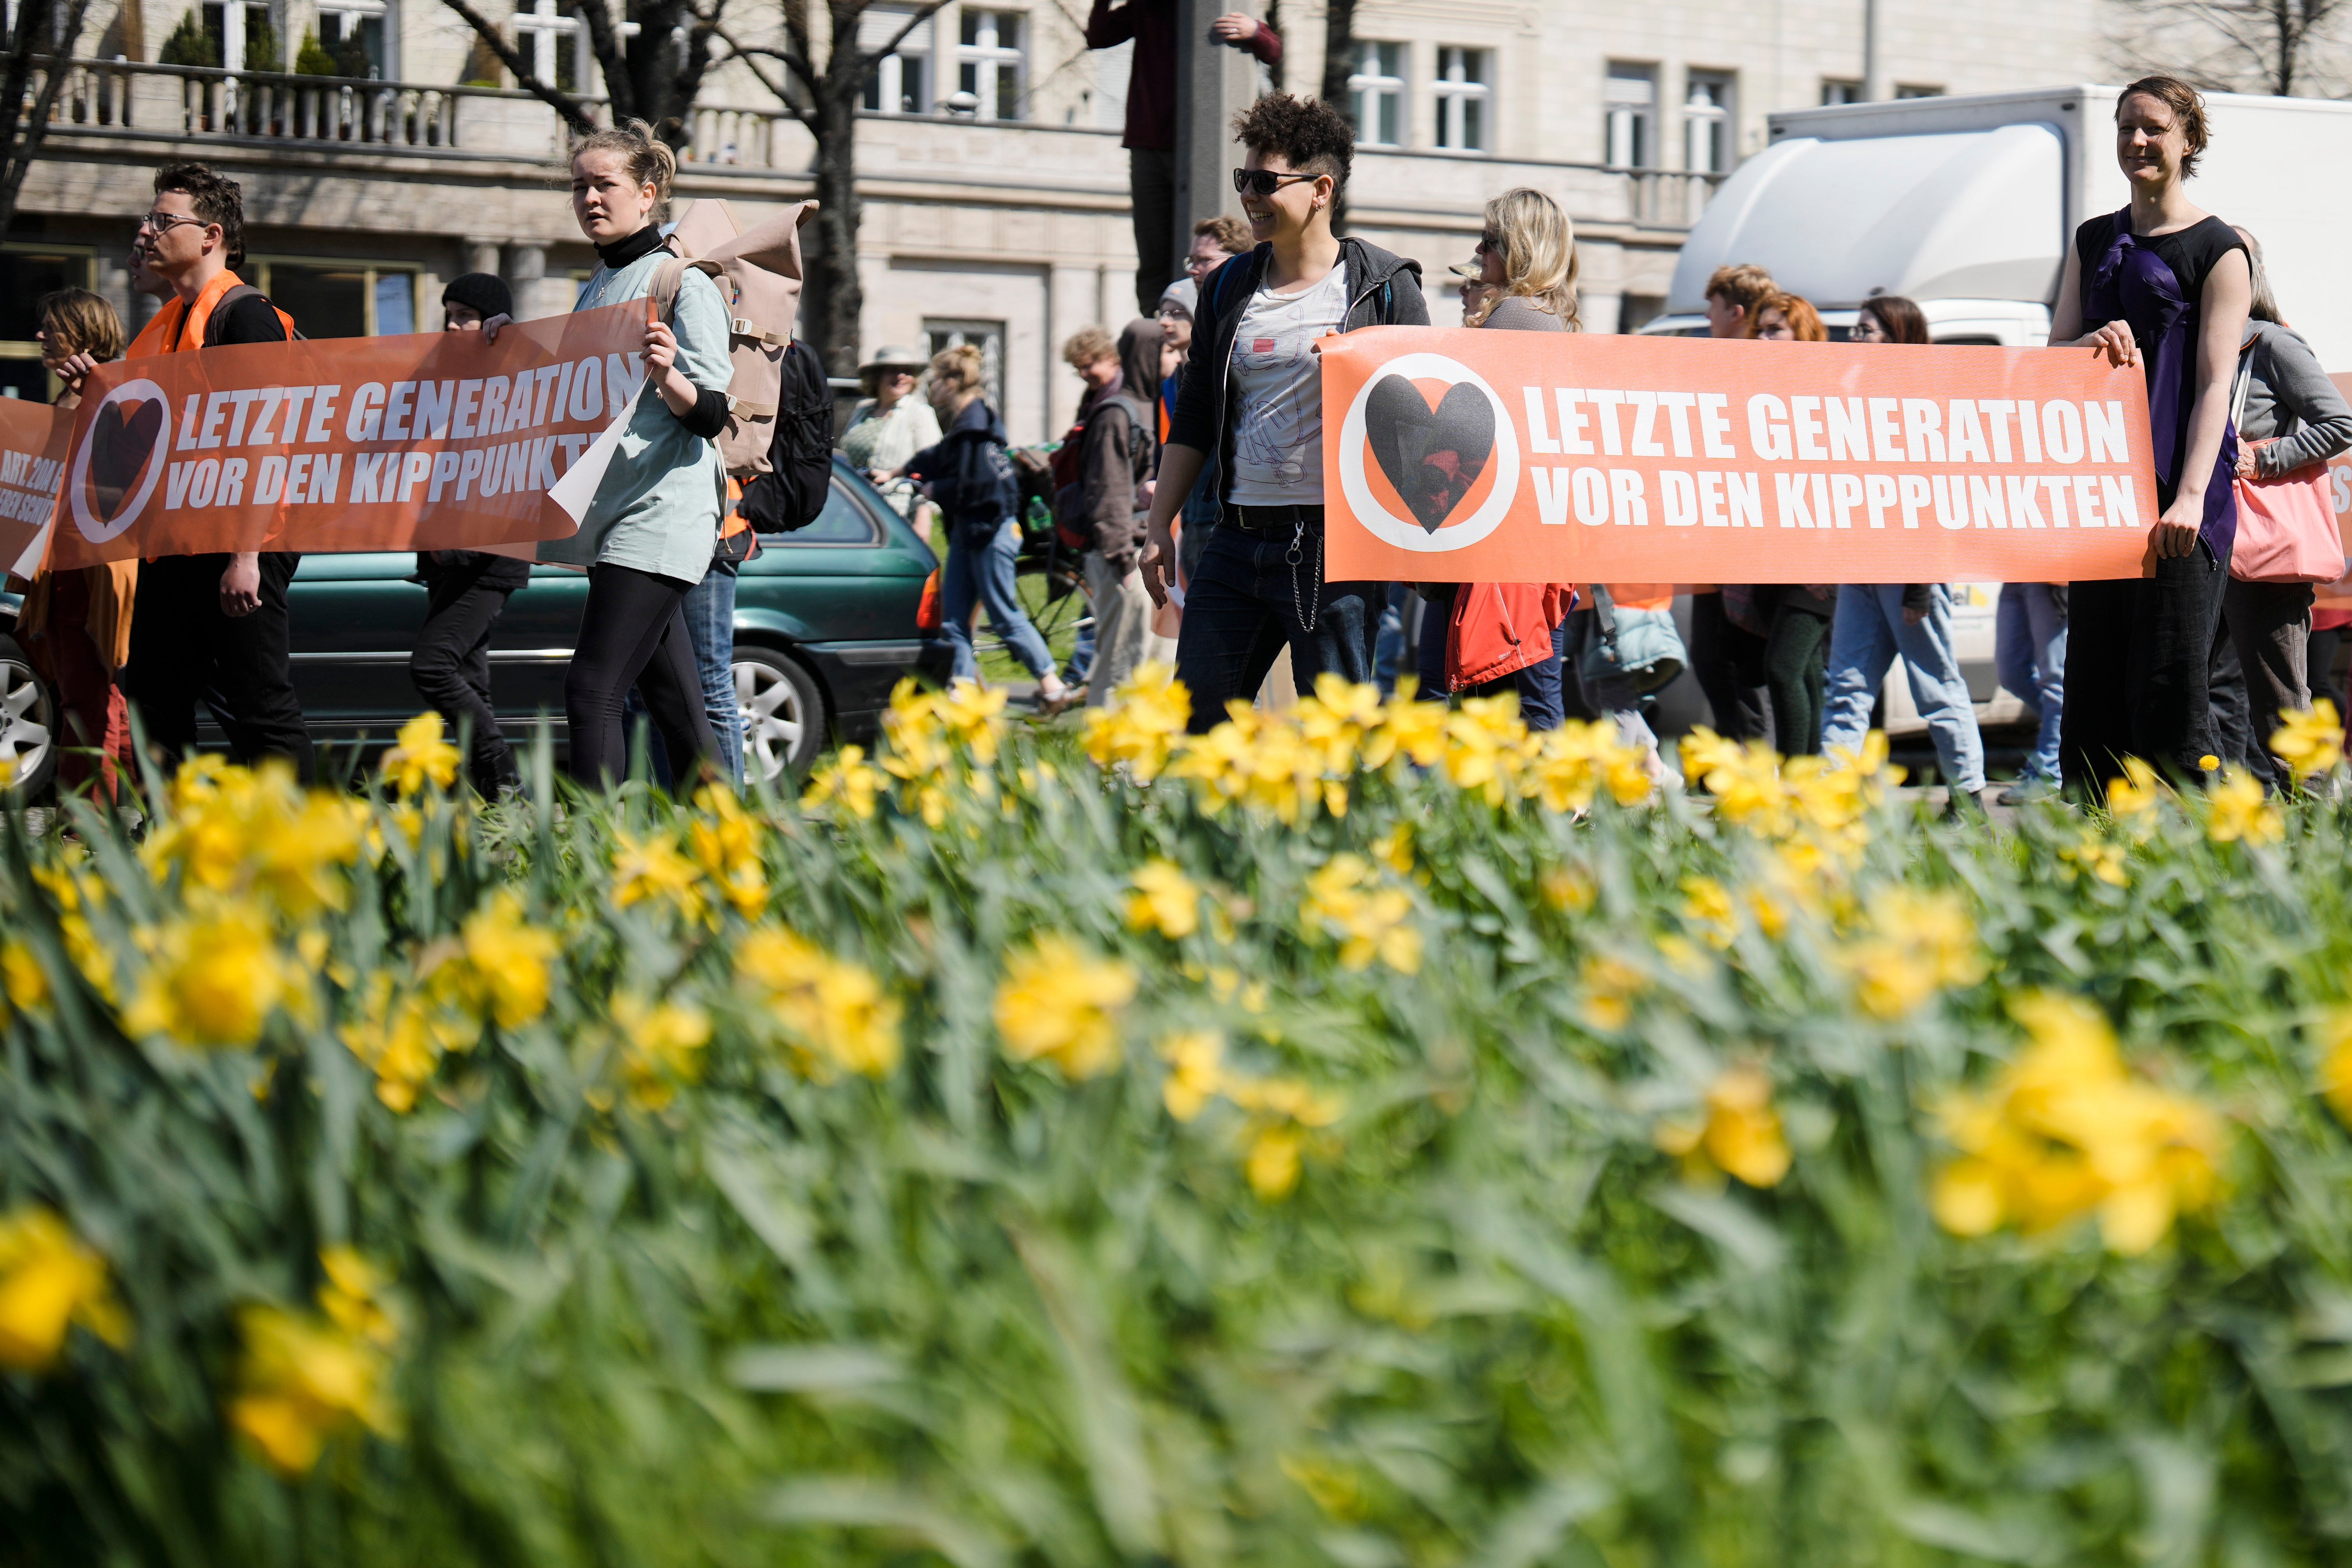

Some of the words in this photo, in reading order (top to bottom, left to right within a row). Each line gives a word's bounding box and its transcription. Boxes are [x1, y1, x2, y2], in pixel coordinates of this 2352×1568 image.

[176, 384, 341, 451] LETZTE
[345, 352, 644, 442] GENERATION
[1522, 387, 1736, 459] LETZTE
[1747, 393, 2130, 464] GENERATION
[0, 449, 32, 487] ART.
[165, 457, 248, 510] VOR
[252, 453, 343, 505] DEN
[349, 432, 603, 503] KIPPPUNKT
[1529, 466, 1648, 526] VOR
[1659, 470, 1764, 528] DEN
[1774, 472, 2140, 530] KIPPPUNKTEN
